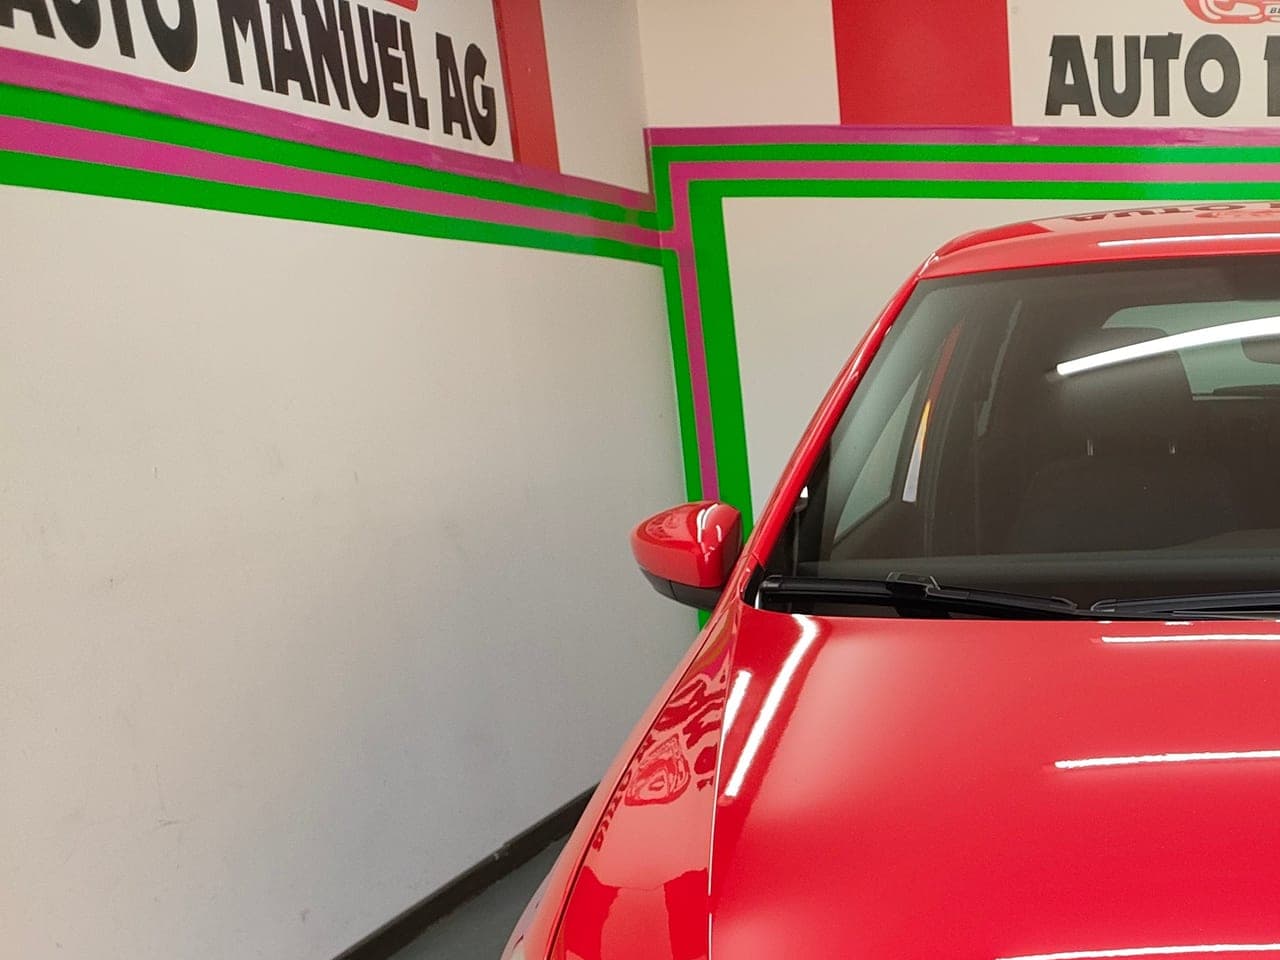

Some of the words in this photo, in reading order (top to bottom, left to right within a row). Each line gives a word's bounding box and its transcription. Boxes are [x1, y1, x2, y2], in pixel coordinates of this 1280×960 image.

[216, 0, 430, 131] MANUEL
[435, 32, 497, 147] AG
[1044, 32, 1242, 118] AUTO
